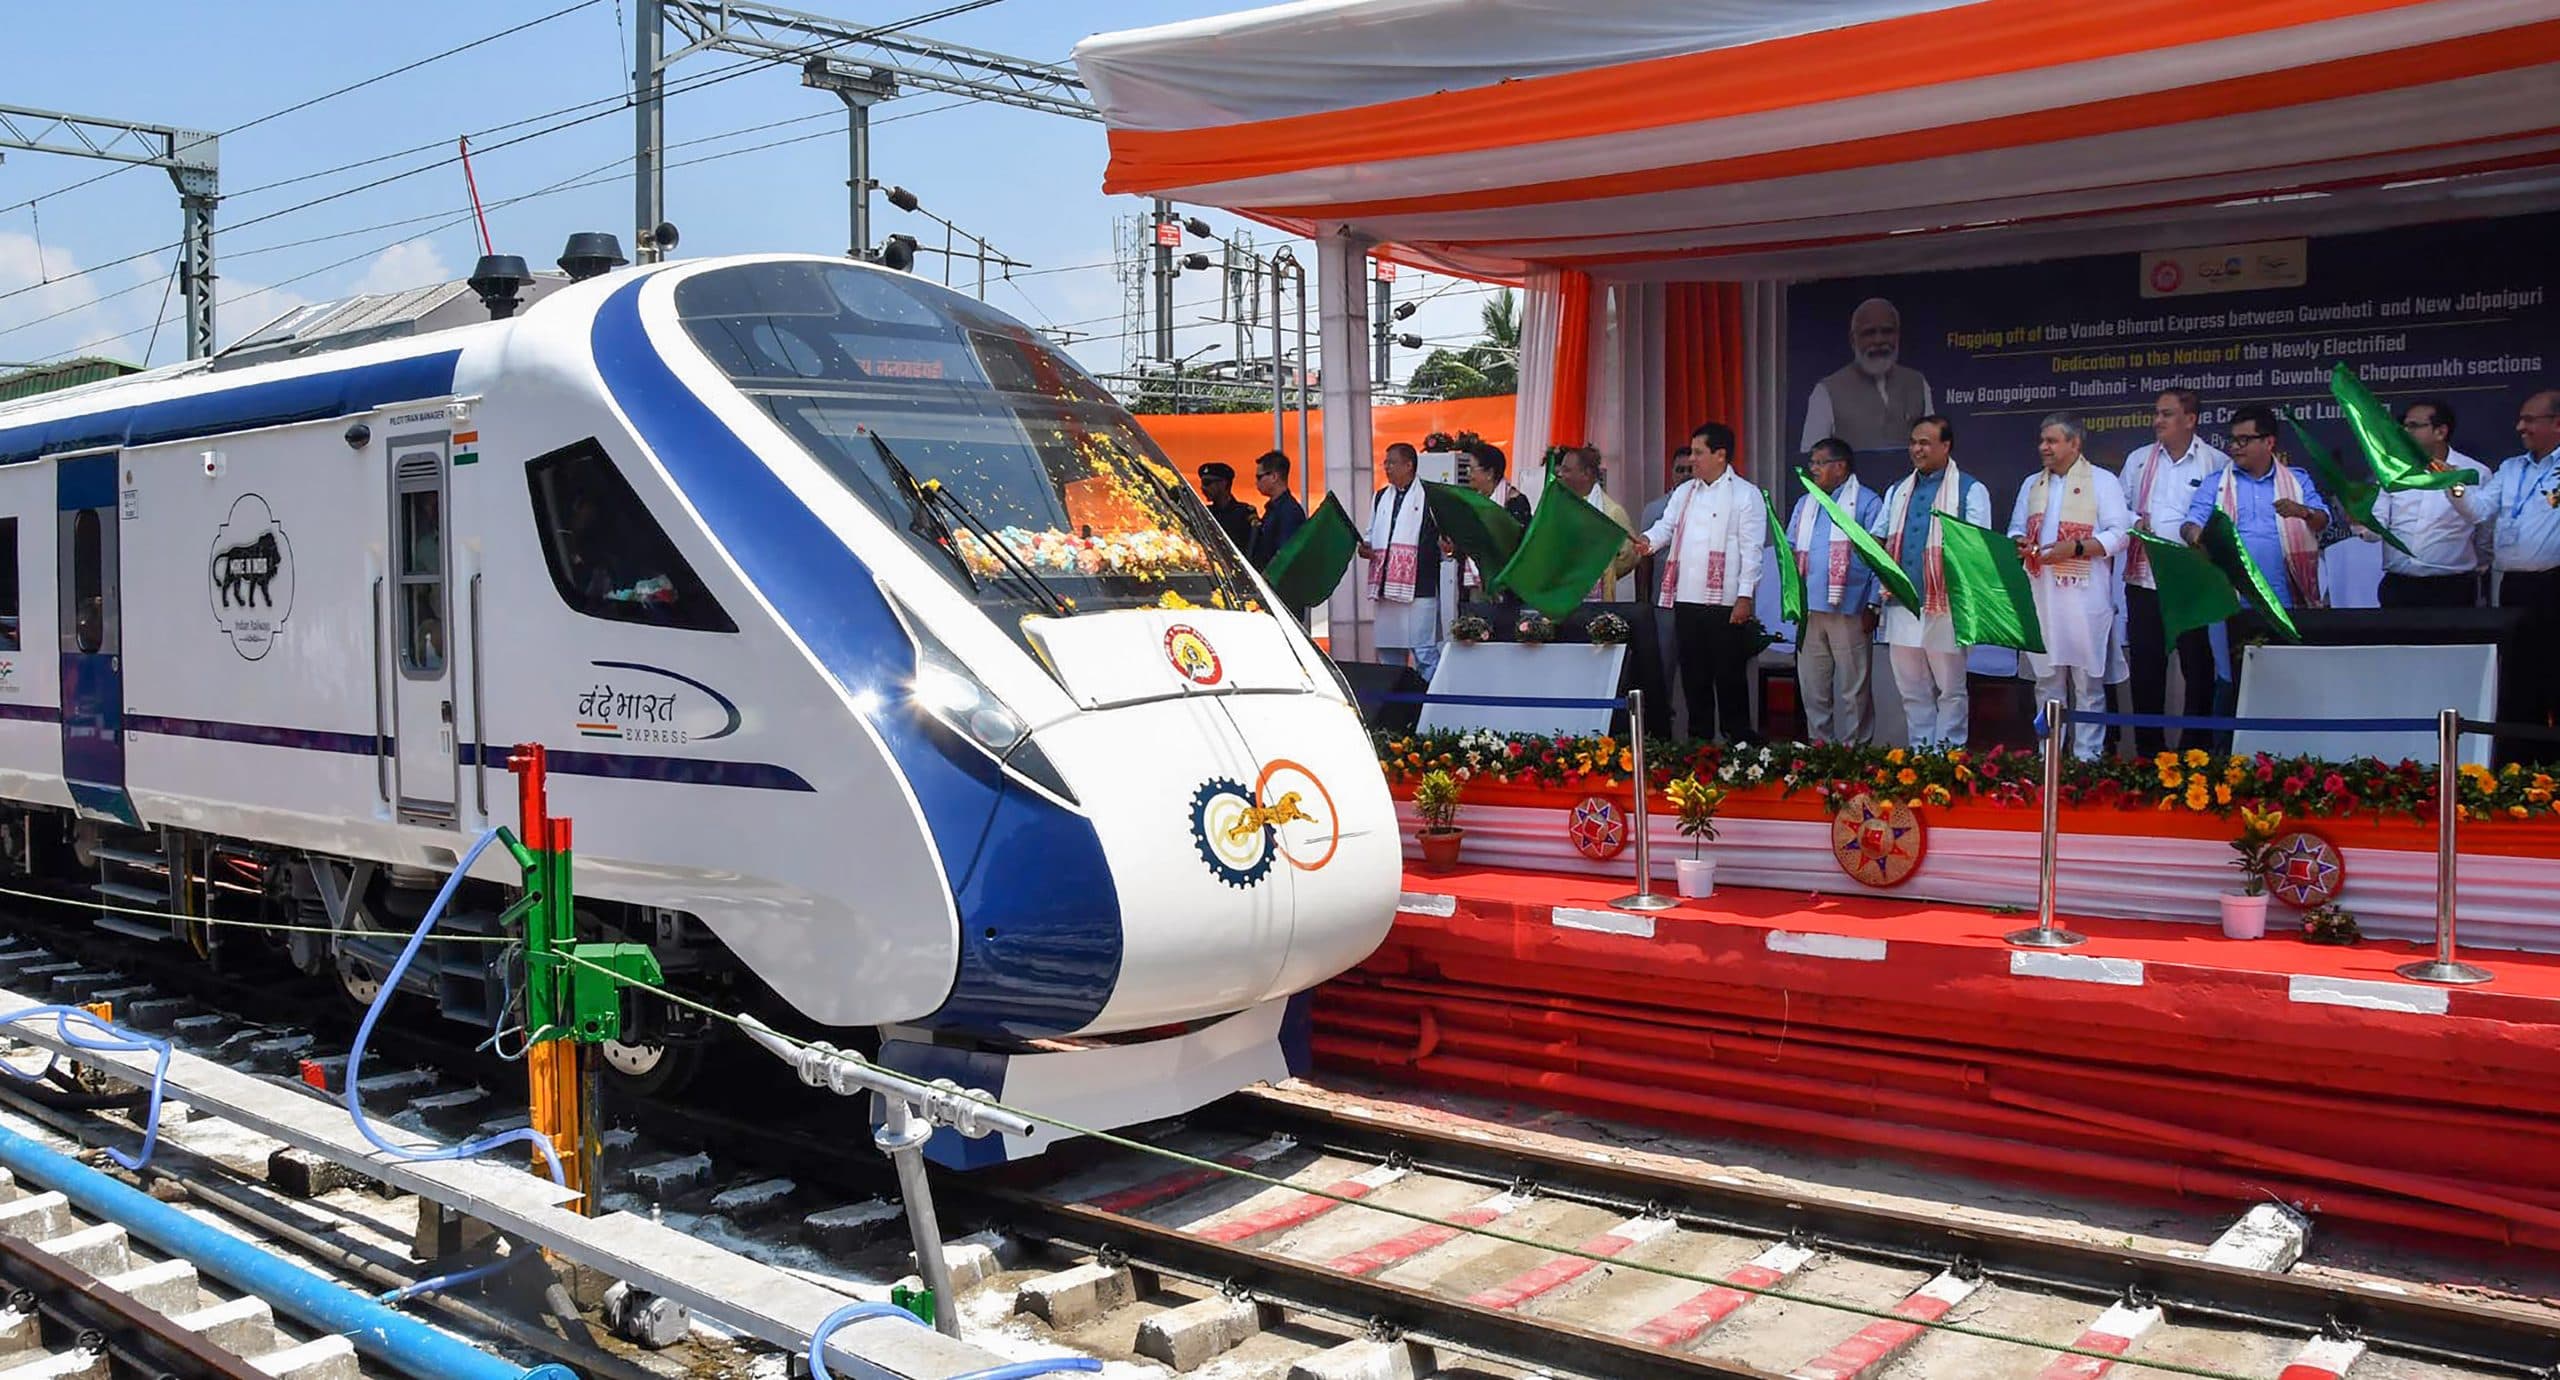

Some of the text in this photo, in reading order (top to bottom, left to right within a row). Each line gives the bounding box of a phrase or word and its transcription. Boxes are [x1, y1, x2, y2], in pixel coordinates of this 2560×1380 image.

[1947, 286, 2544, 351] Flagging off of the Vande Bharat Express between Guwahati and New Jalpaiguri
[2051, 332, 2406, 373] Dedication to the Nation of the Newly Electrified
[1946, 388, 1975, 405] New
[2235, 368, 2263, 387] and
[2271, 364, 2333, 386] Guwaha
[2360, 357, 2463, 383] Chaparmukh
[2467, 354, 2542, 376] sections
[2294, 403, 2312, 420] at
[626, 728, 689, 744] EXPRESS
